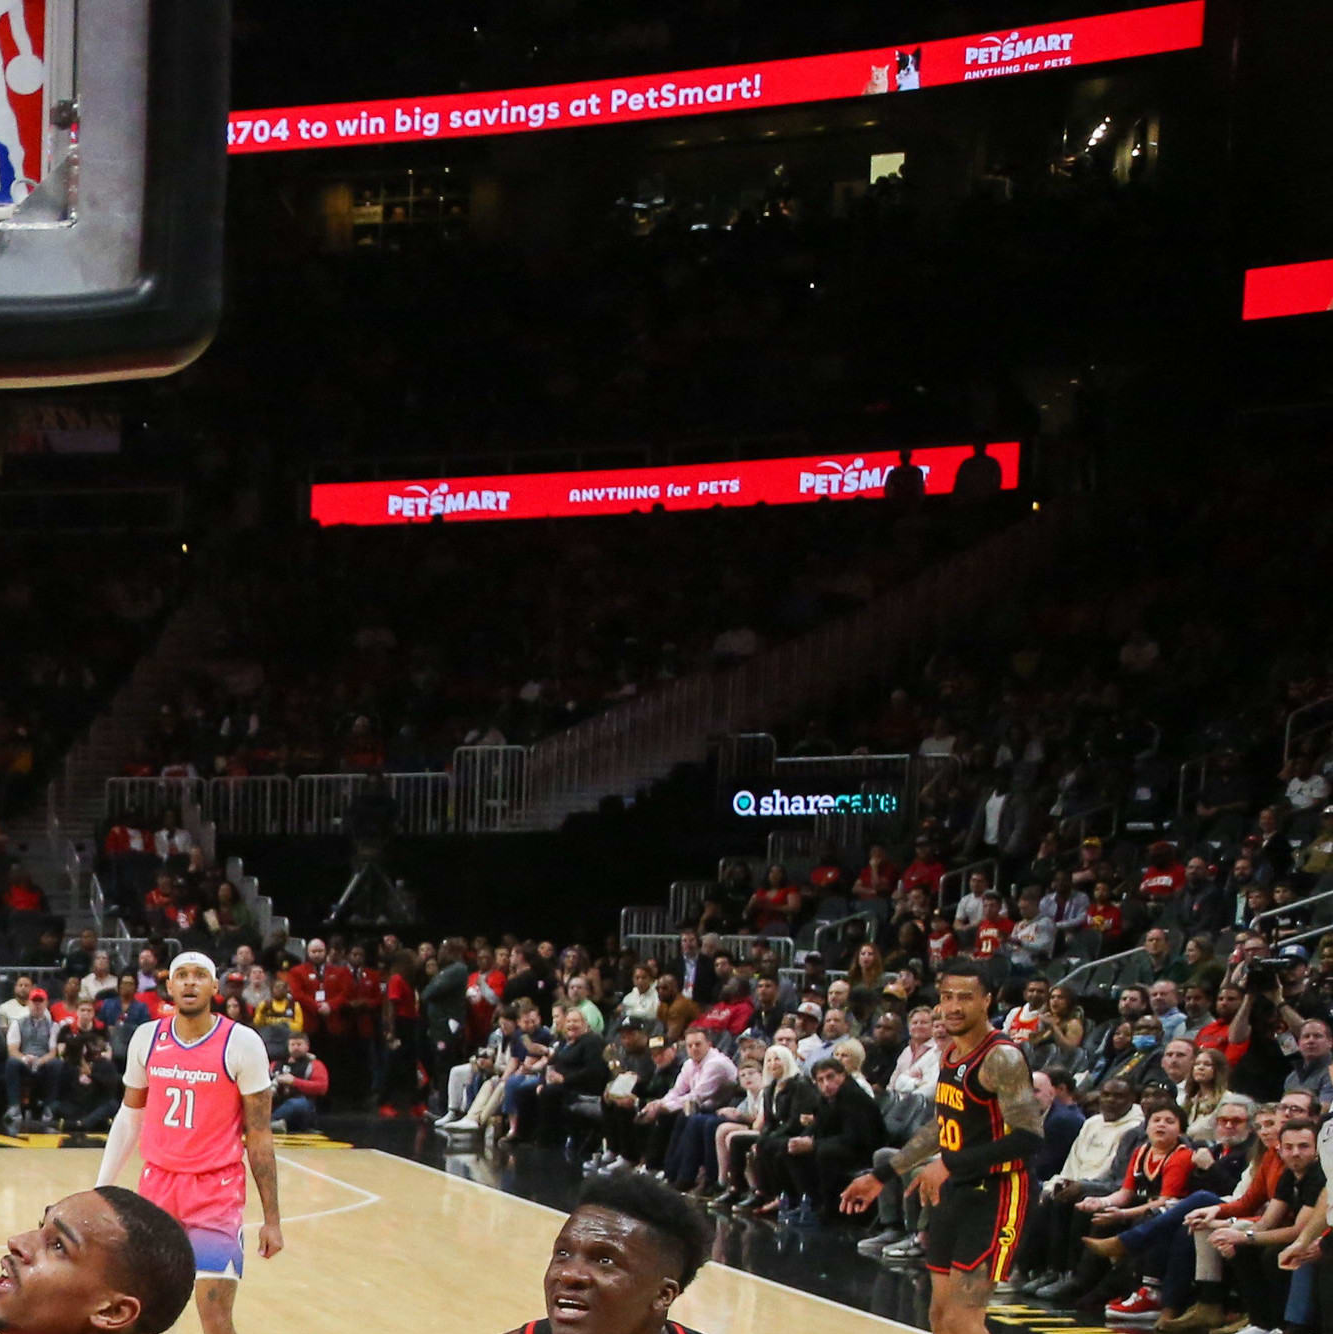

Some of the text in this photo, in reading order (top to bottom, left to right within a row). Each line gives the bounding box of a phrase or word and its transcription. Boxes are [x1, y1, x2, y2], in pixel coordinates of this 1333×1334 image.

[964, 31, 1074, 65] PETSMART
[964, 56, 1072, 80] ANYTHING for PETS
[297, 118, 328, 140] to
[335, 111, 385, 137] win
[394, 107, 440, 137] big
[449, 100, 560, 128] savings
[569, 93, 601, 118] at
[610, 73, 762, 113] PetSmart!
[568, 479, 741, 503] ANYTHING for PETS
[799, 458, 930, 495] PETSM
[388, 483, 511, 517] PETSMART
[149, 1064, 218, 1084] washington
[163, 1087, 195, 1129] 21
[937, 1114, 963, 1152] 20
